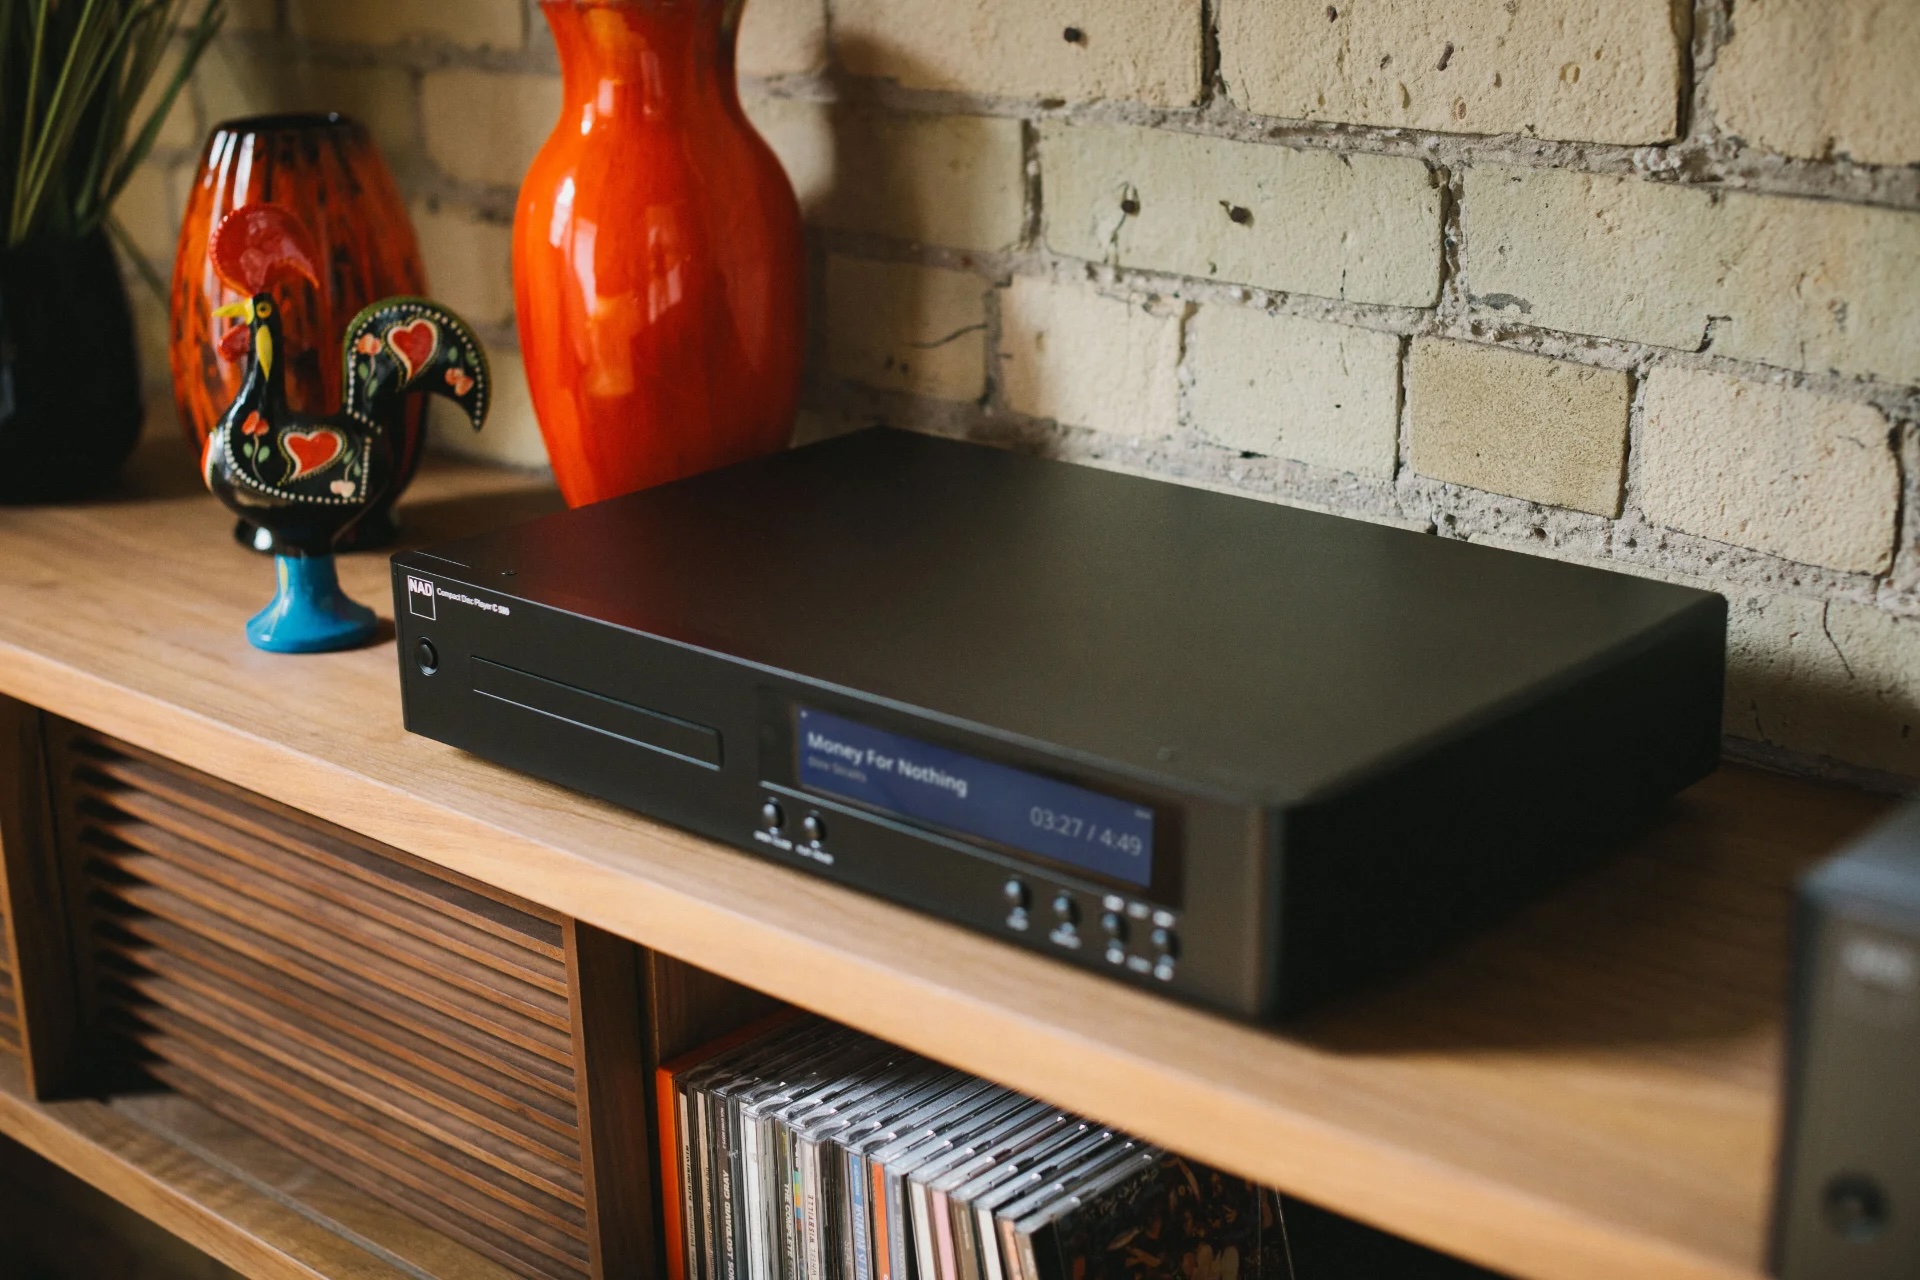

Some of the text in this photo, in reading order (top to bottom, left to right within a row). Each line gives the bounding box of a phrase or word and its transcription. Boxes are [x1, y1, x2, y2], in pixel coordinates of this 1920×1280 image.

[409, 579, 433, 597] NAD
[436, 587, 461, 600] Compact
[461, 594, 475, 605] Disc
[474, 598, 492, 610] Player
[807, 731, 968, 799] Money For Nothing
[1030, 805, 1083, 837] 03:27
[1100, 828, 1142, 857] 4:49
[784, 1204, 793, 1257] COMPLETE
